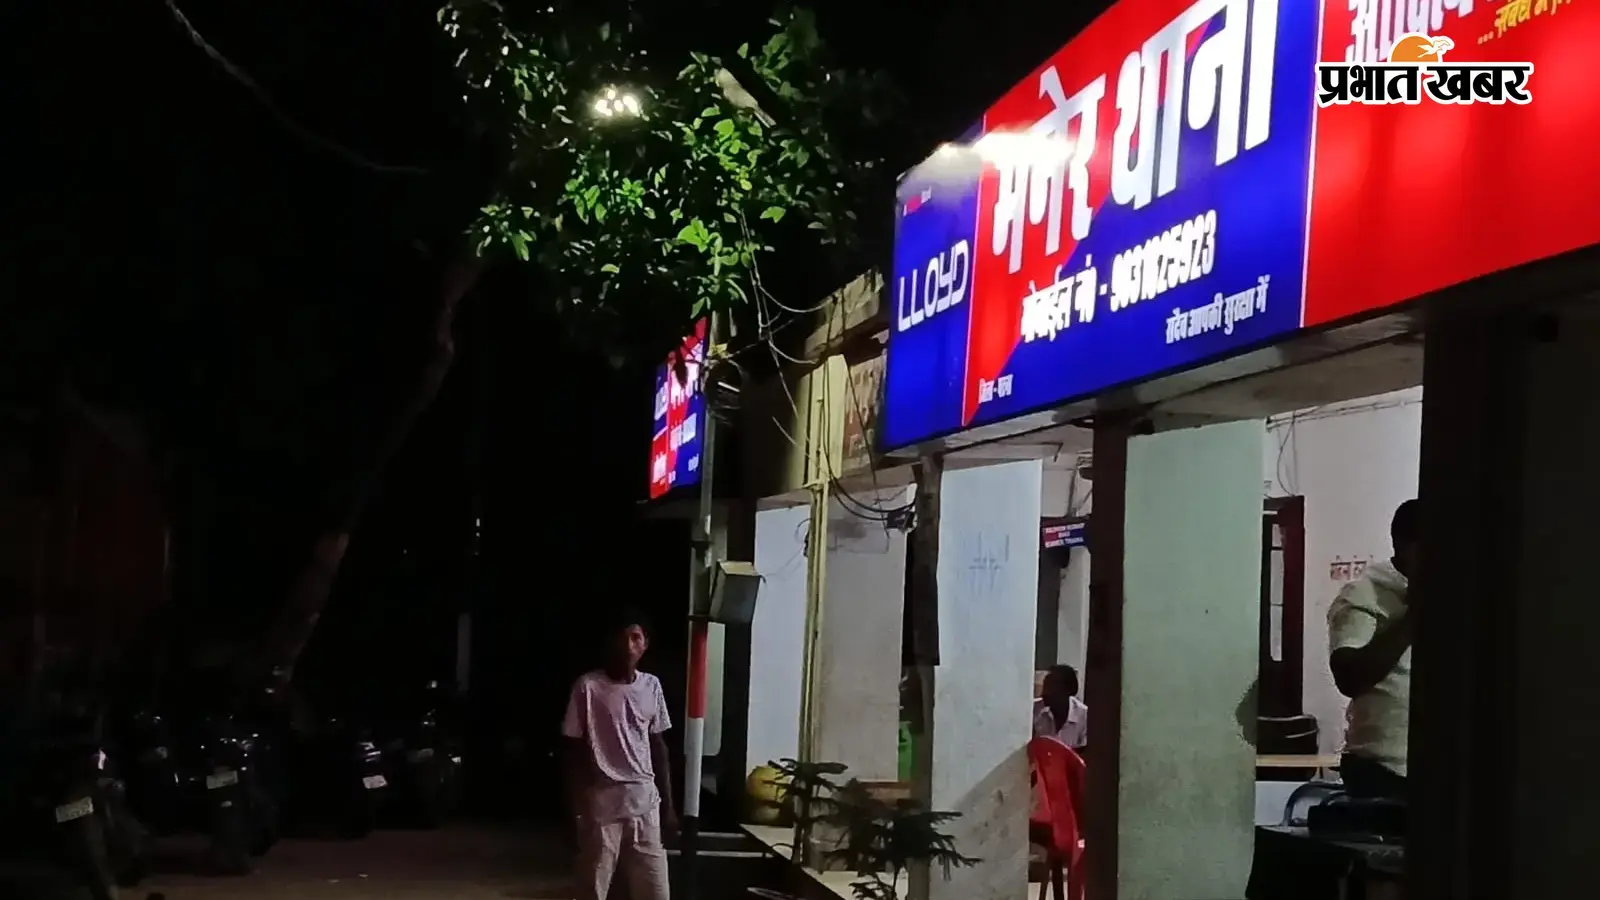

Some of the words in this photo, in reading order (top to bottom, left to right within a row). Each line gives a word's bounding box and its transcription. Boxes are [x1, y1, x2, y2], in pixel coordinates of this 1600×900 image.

[990, 65, 1106, 274] मनेर
[1111, 0, 1279, 211] थाना
[898, 239, 969, 332] LLOYD
[1188, 292, 1224, 337] आपकी
[1224, 287, 1256, 335] सुरक्षा
[1256, 274, 1271, 313] में
